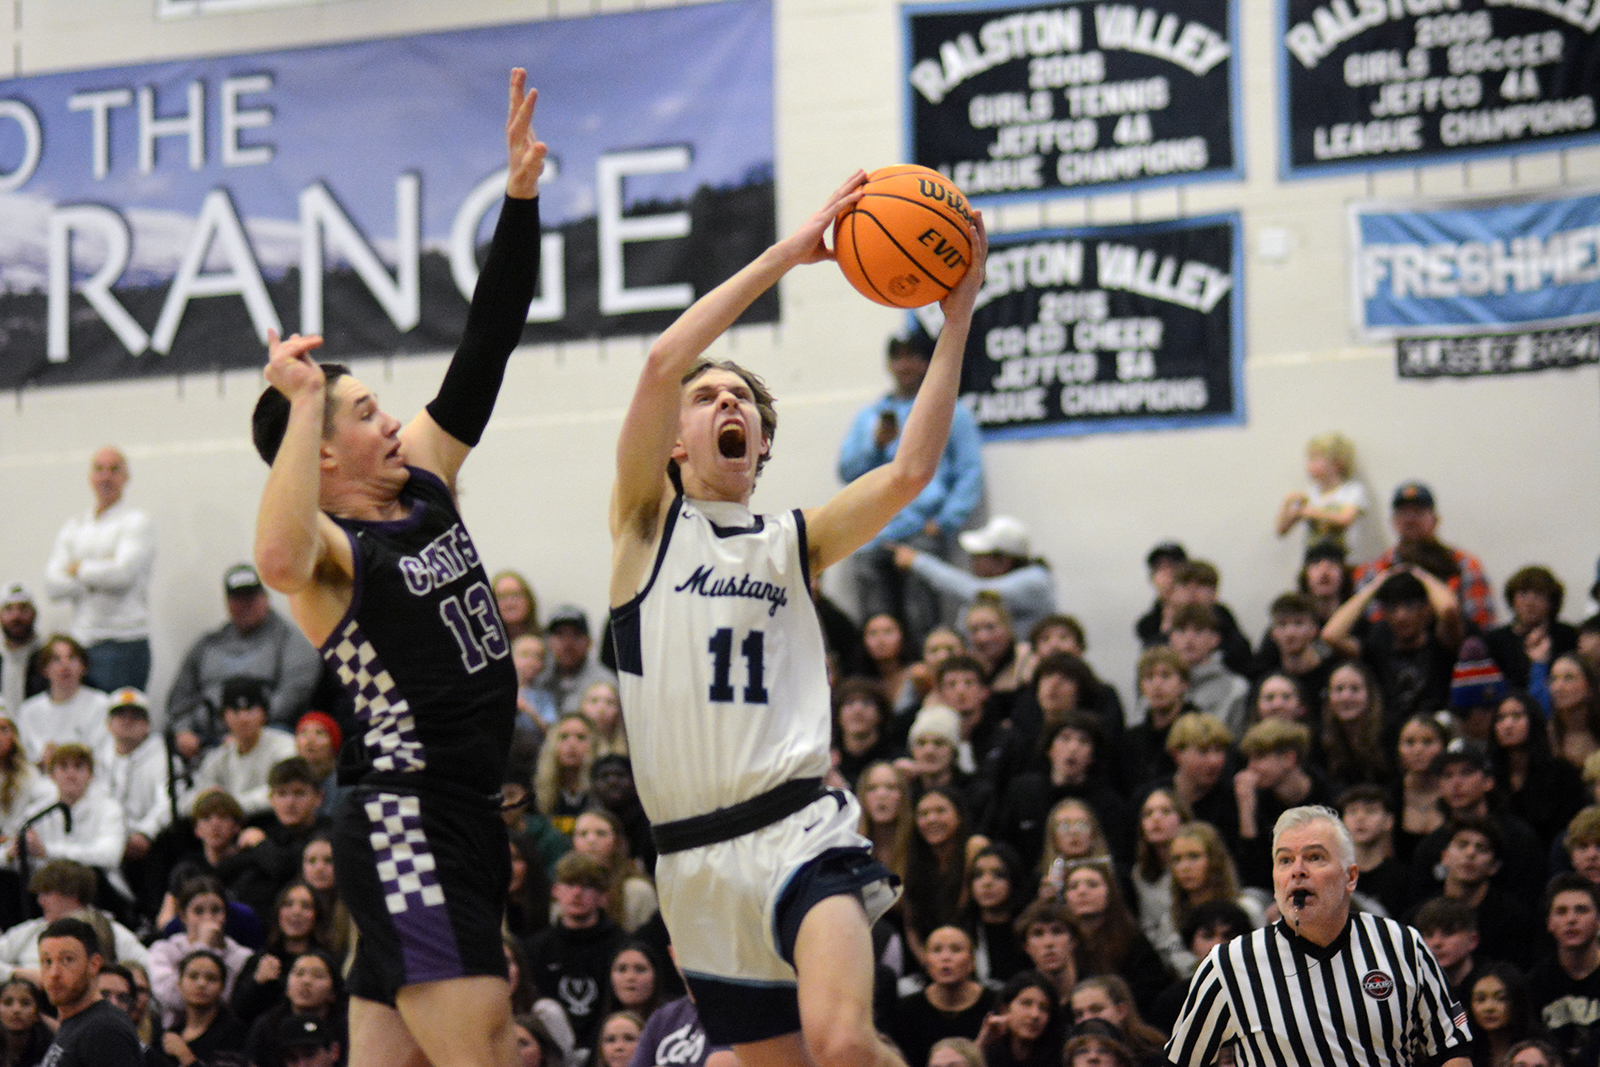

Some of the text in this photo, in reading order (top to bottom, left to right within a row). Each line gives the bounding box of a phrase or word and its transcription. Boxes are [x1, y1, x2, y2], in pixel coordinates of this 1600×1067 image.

[909, 3, 1232, 105] RALSTON VALLEY
[1344, 30, 1564, 87] GIRLS SOCCER
[968, 76, 1171, 129] GIRLS TENNIS
[1370, 67, 1540, 117] JEFFCO 4A
[68, 73, 275, 181] THE
[987, 113, 1152, 159] JEFFCO 4A
[1313, 94, 1596, 160] LEAGUE CHAMPIONS
[1056, 136, 1209, 186] CHAMPIONS
[47, 146, 695, 363] RANGE
[1097, 242, 1233, 314] VALLEY
[1361, 222, 1600, 299] FRESHME
[1073, 316, 1164, 353] CHEER
[992, 352, 1099, 392] JEFFCO
[1060, 376, 1208, 416] CHAMPIONS
[398, 522, 482, 597] CATS
[674, 564, 788, 617] Mustangs
[439, 581, 509, 674] 13
[708, 627, 769, 704] 11
